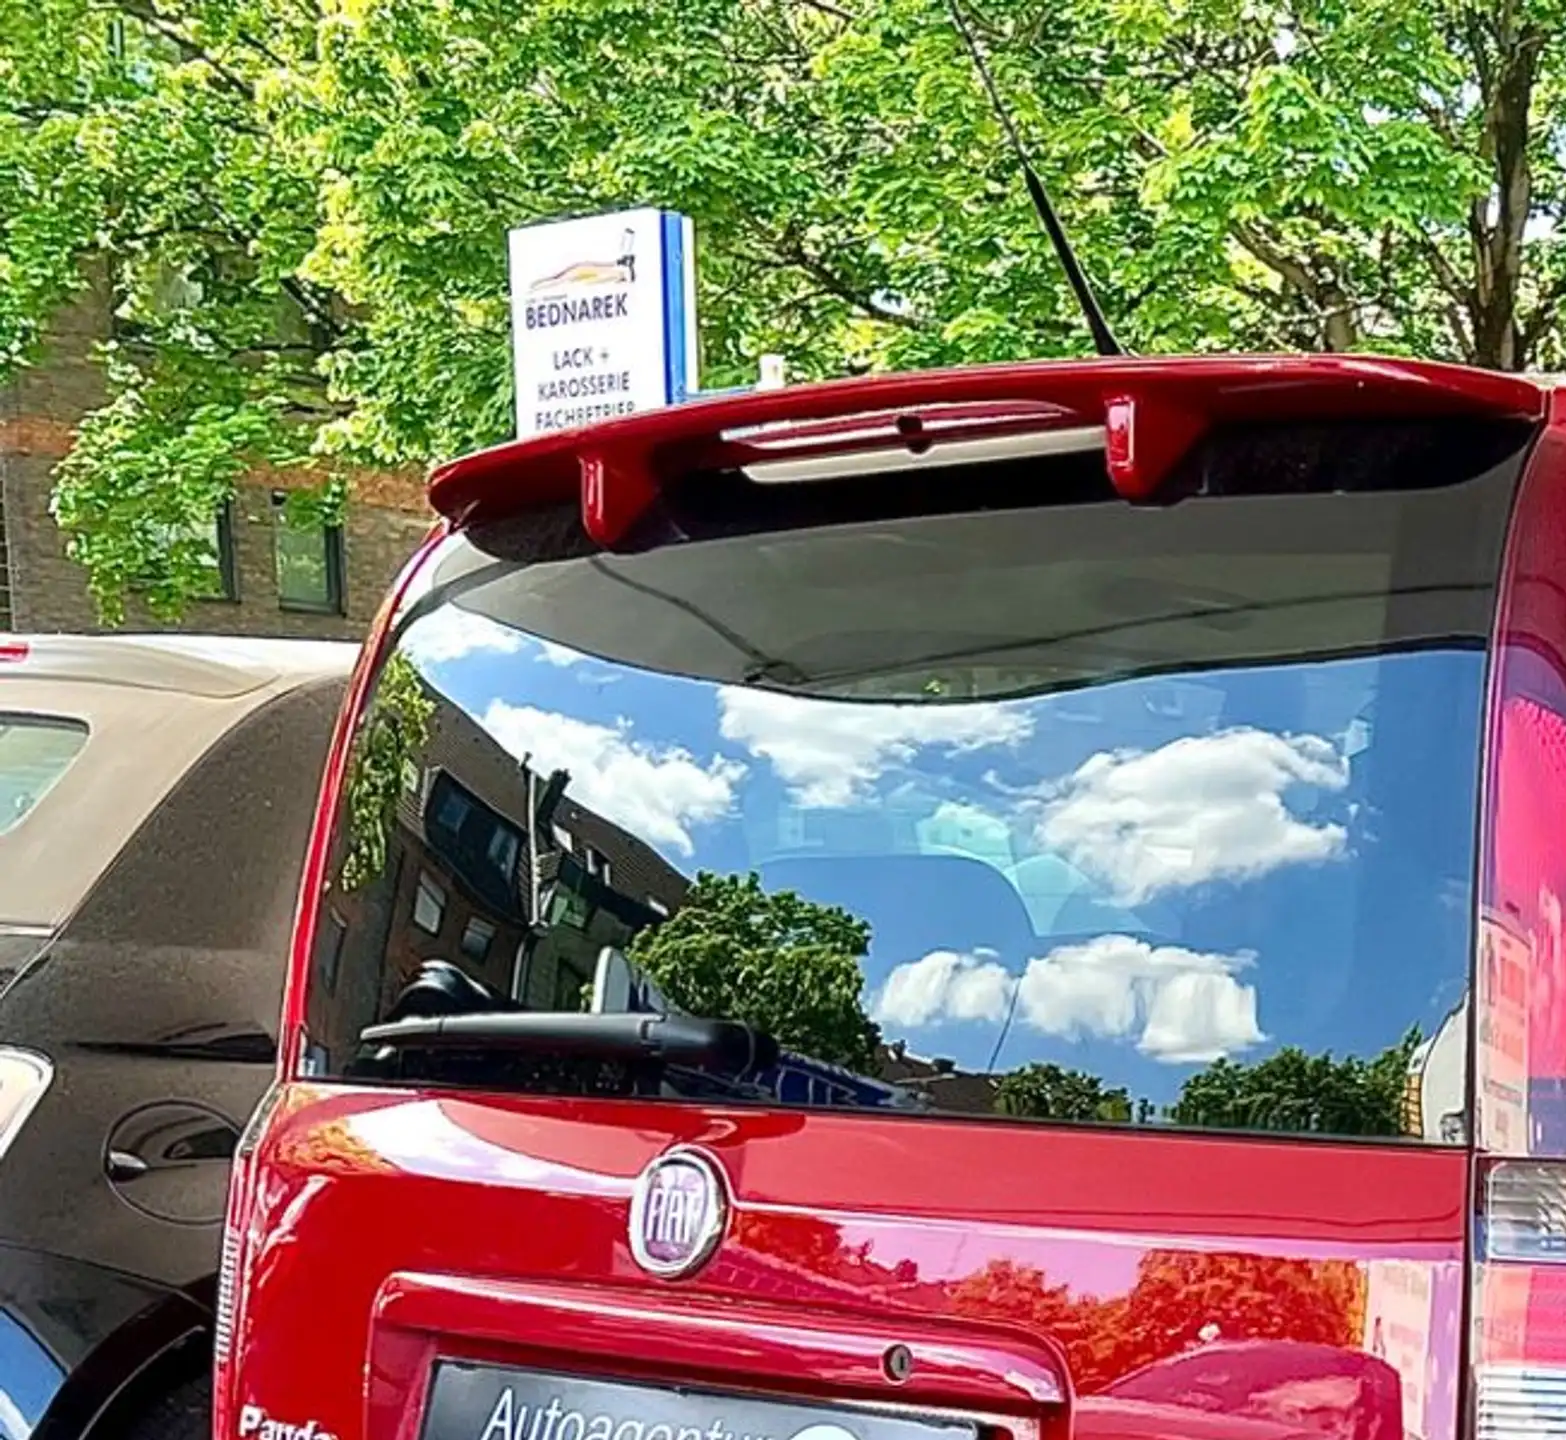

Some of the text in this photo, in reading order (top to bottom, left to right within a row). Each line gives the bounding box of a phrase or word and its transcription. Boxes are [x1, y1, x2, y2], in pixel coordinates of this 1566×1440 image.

[526, 292, 628, 329] BEDNAREK
[553, 347, 593, 370] LACK
[537, 371, 631, 401] KAROSSERIE
[645, 1186, 704, 1244] FIAT
